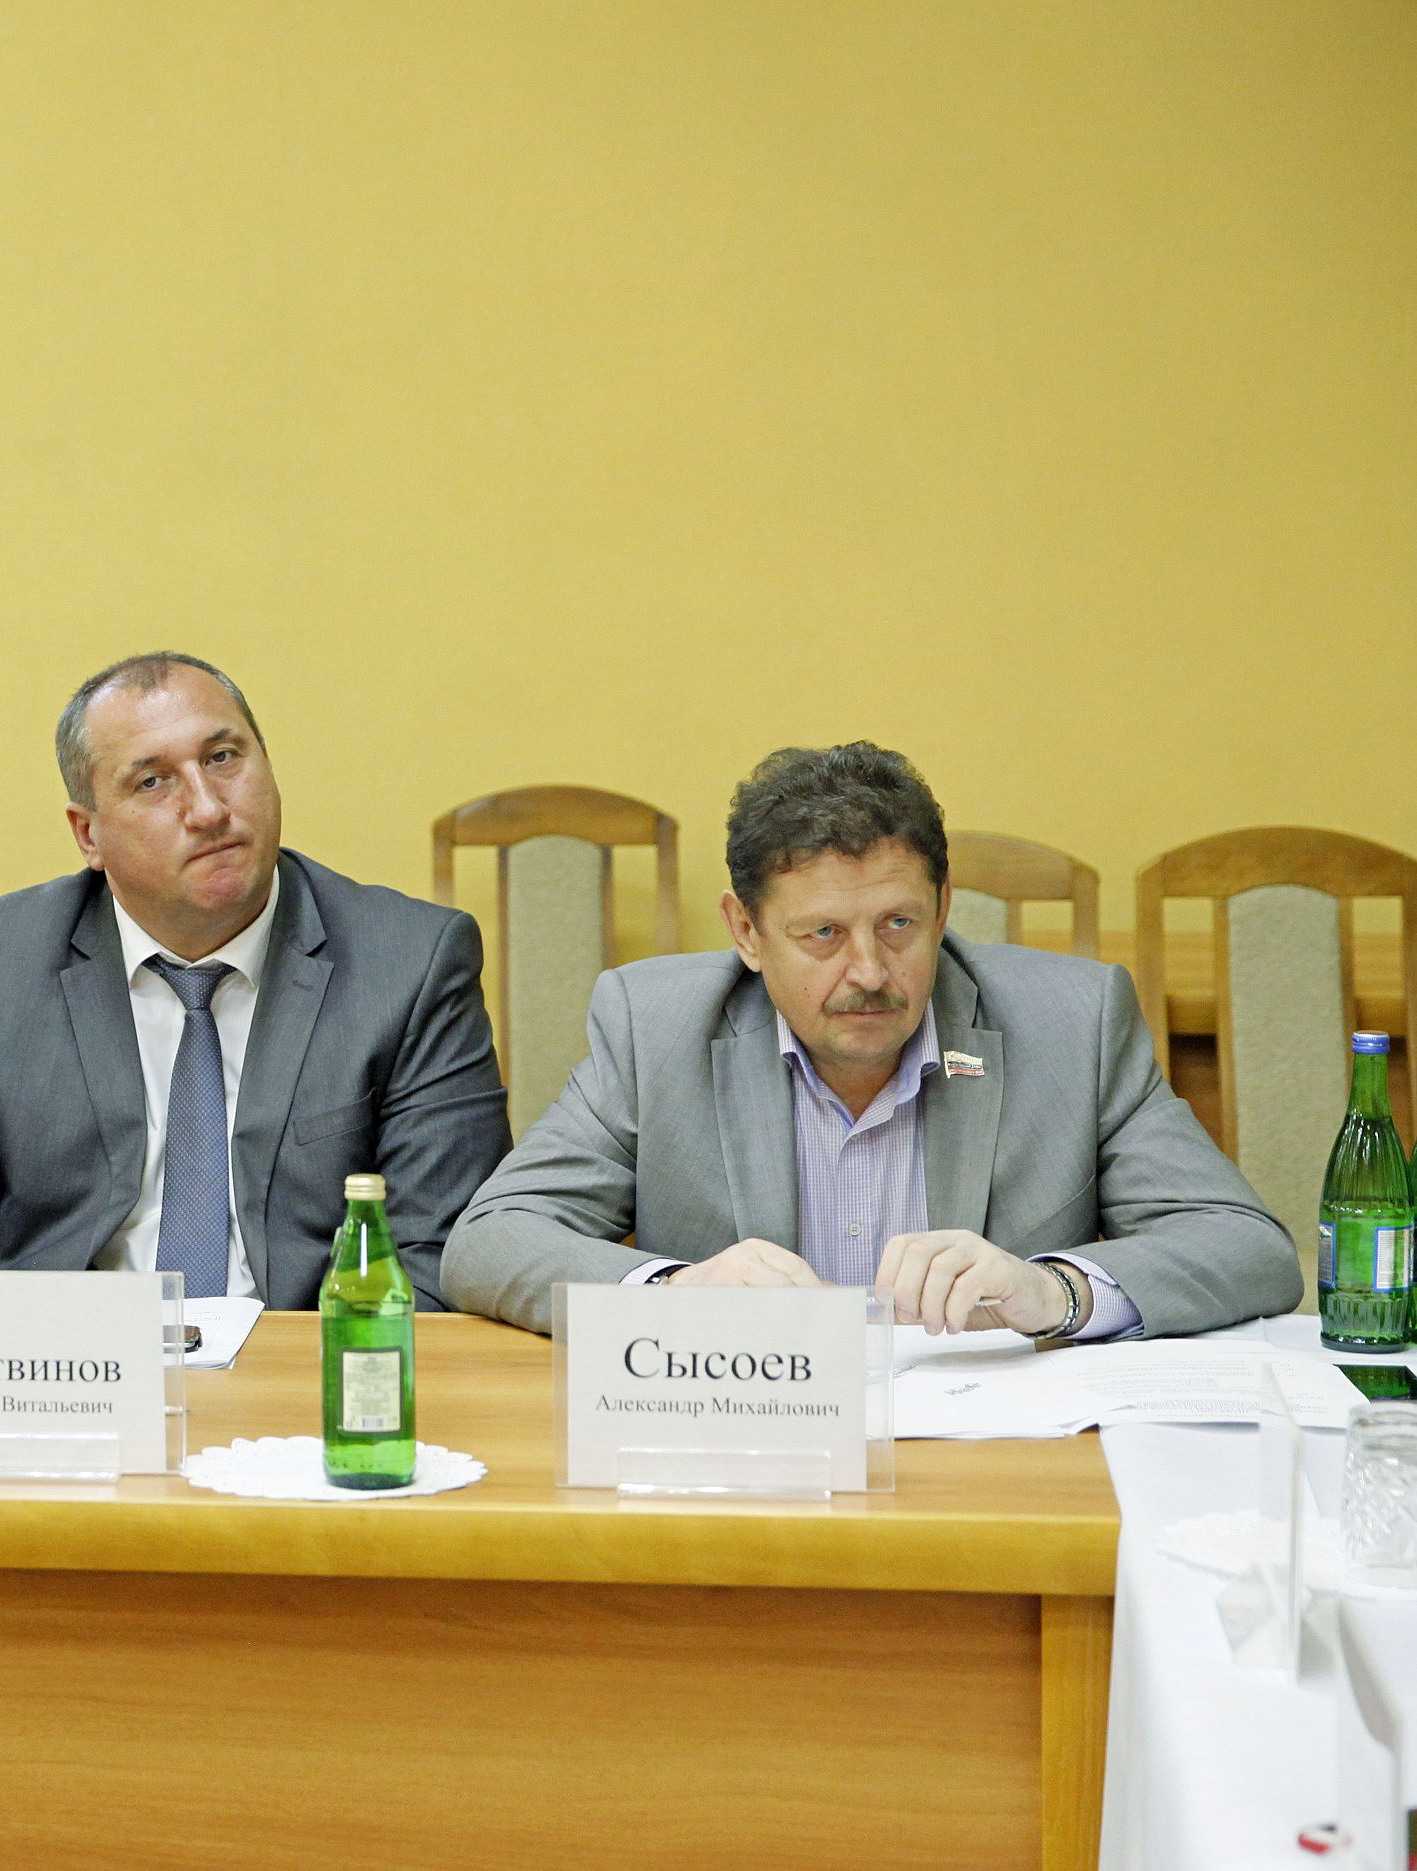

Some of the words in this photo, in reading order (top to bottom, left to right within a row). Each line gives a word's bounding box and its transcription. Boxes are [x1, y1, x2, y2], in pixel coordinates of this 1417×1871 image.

[623, 1337, 812, 1382] Сысоев
[1, 1394, 114, 1415] Витальевич
[596, 1394, 705, 1419] Александр
[712, 1396, 840, 1418] Михайлович
